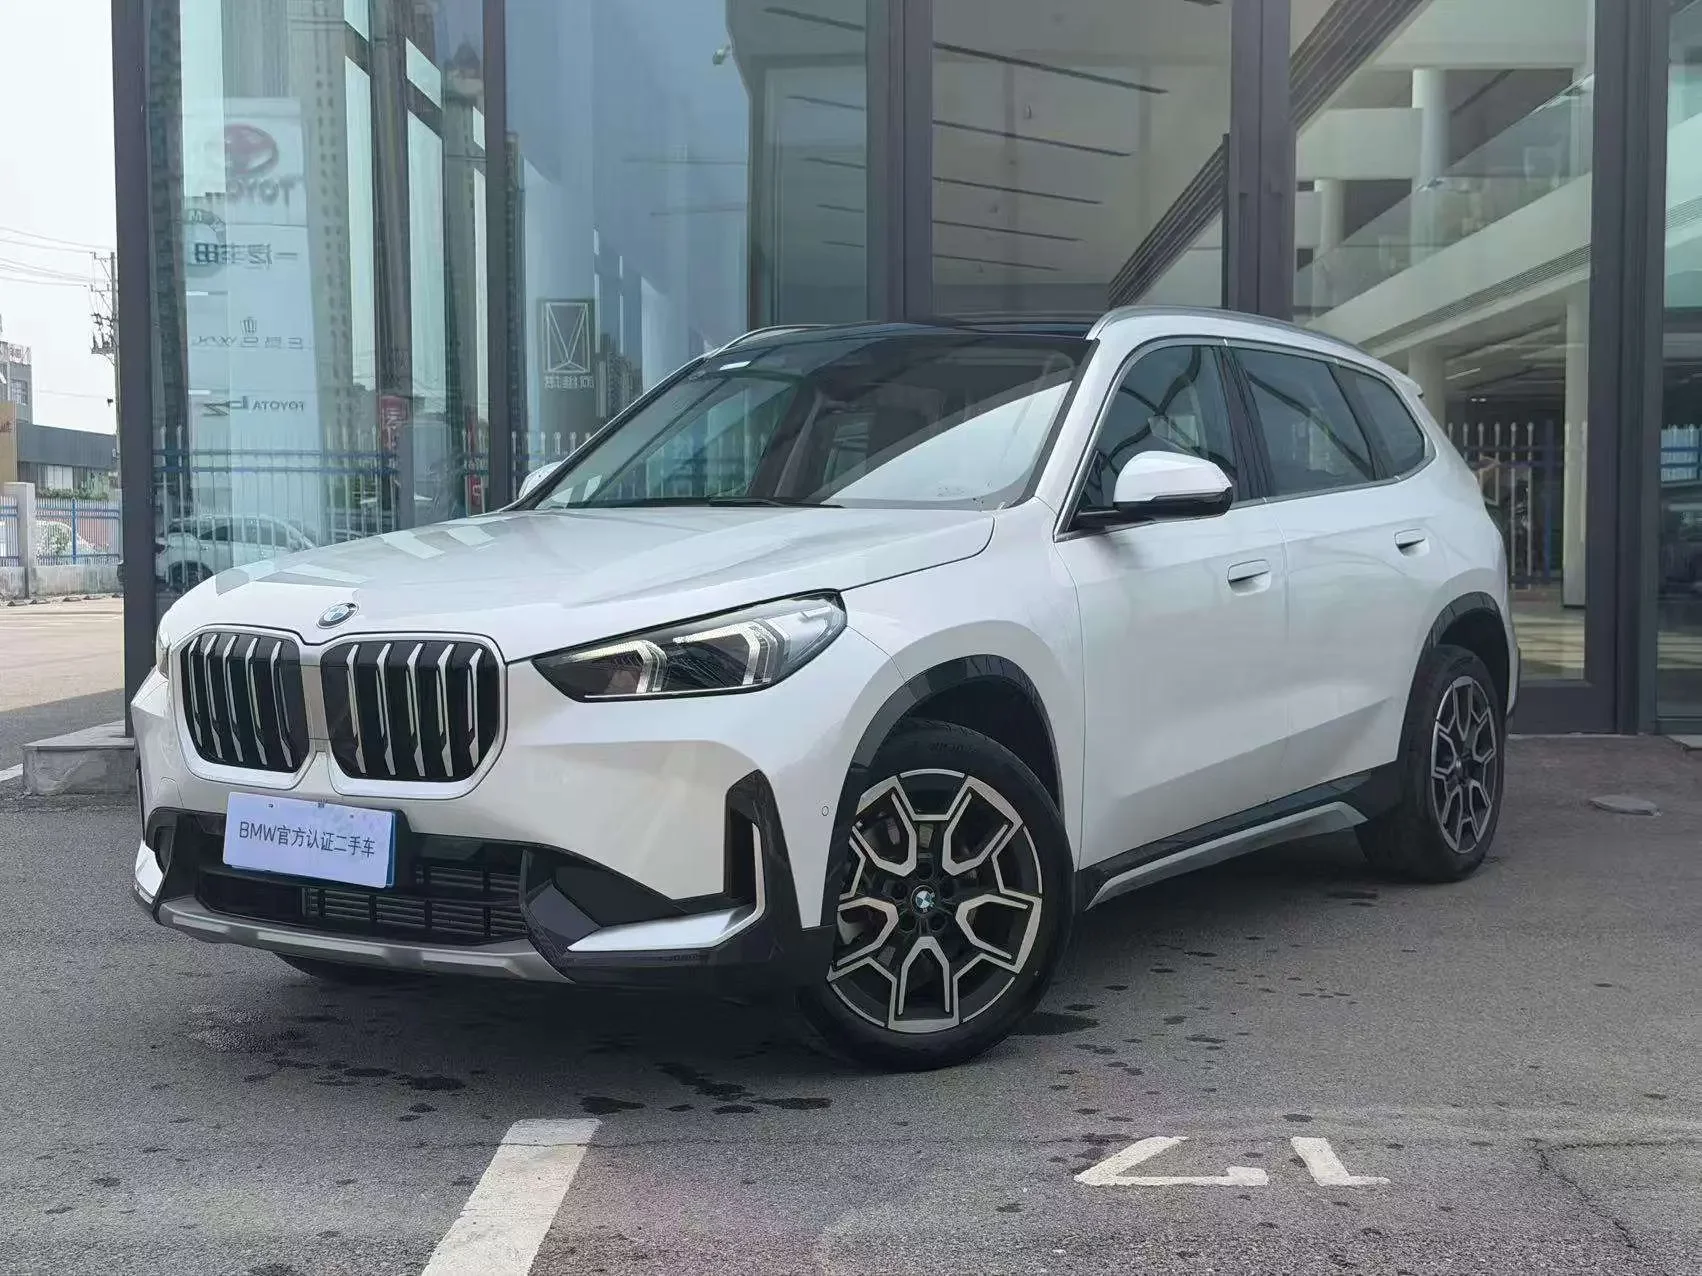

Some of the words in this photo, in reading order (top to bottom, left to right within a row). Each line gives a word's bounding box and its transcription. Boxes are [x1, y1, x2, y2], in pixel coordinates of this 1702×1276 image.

[239, 820, 376, 858] BMW官方认证二手车
